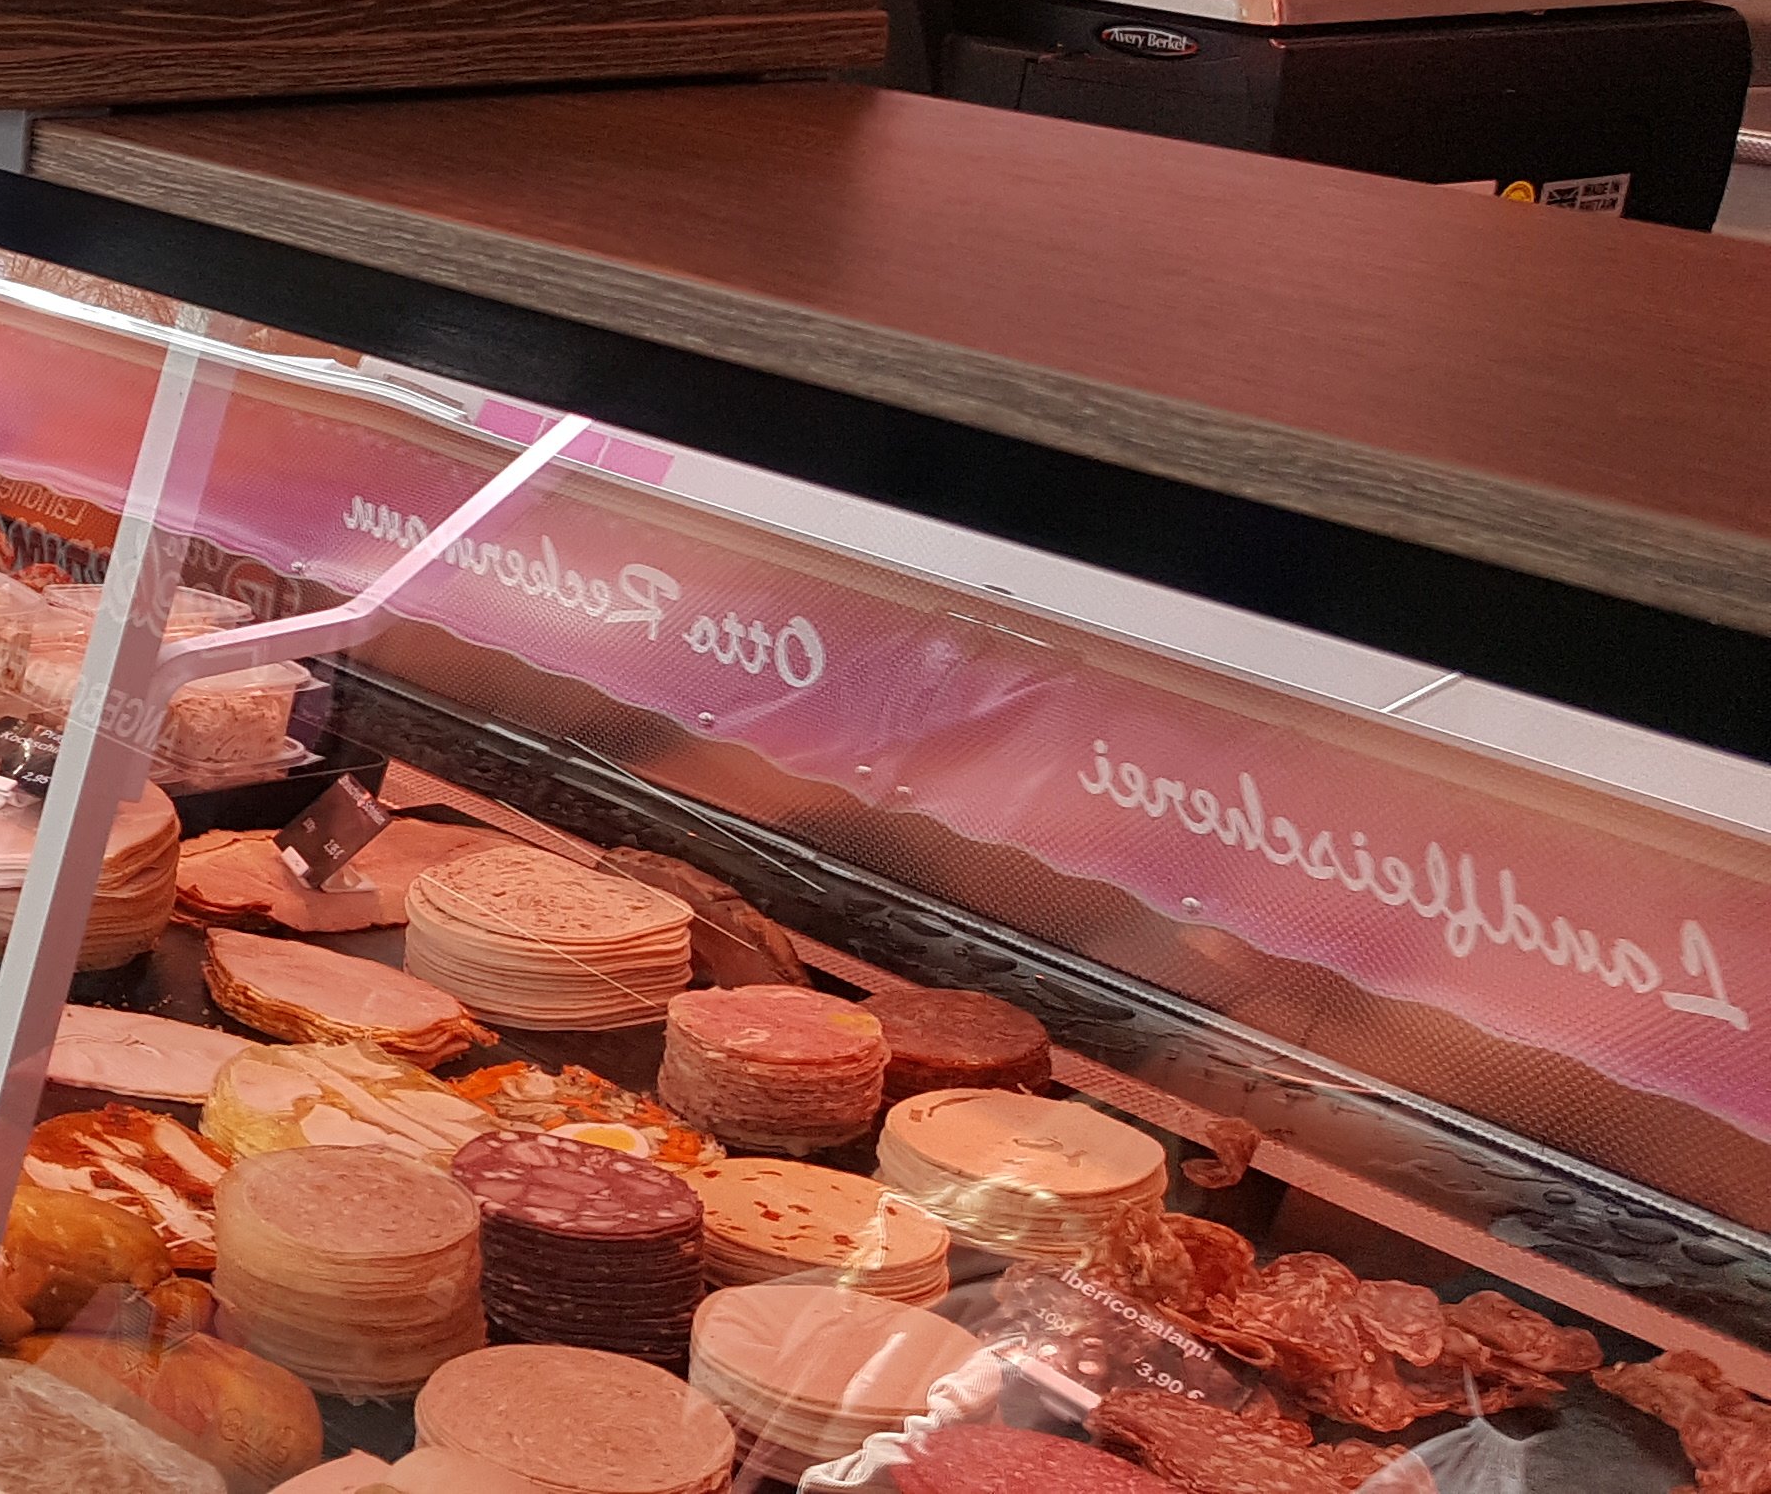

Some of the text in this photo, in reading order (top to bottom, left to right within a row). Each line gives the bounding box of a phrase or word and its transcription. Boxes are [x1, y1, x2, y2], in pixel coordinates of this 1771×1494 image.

[1110, 30, 1187, 51] Avery Berkel
[1034, 1308, 1074, 1337] 100g
[1134, 1362, 1184, 1394] 3,90
[1060, 1269, 1216, 1363] Ibericosalami
